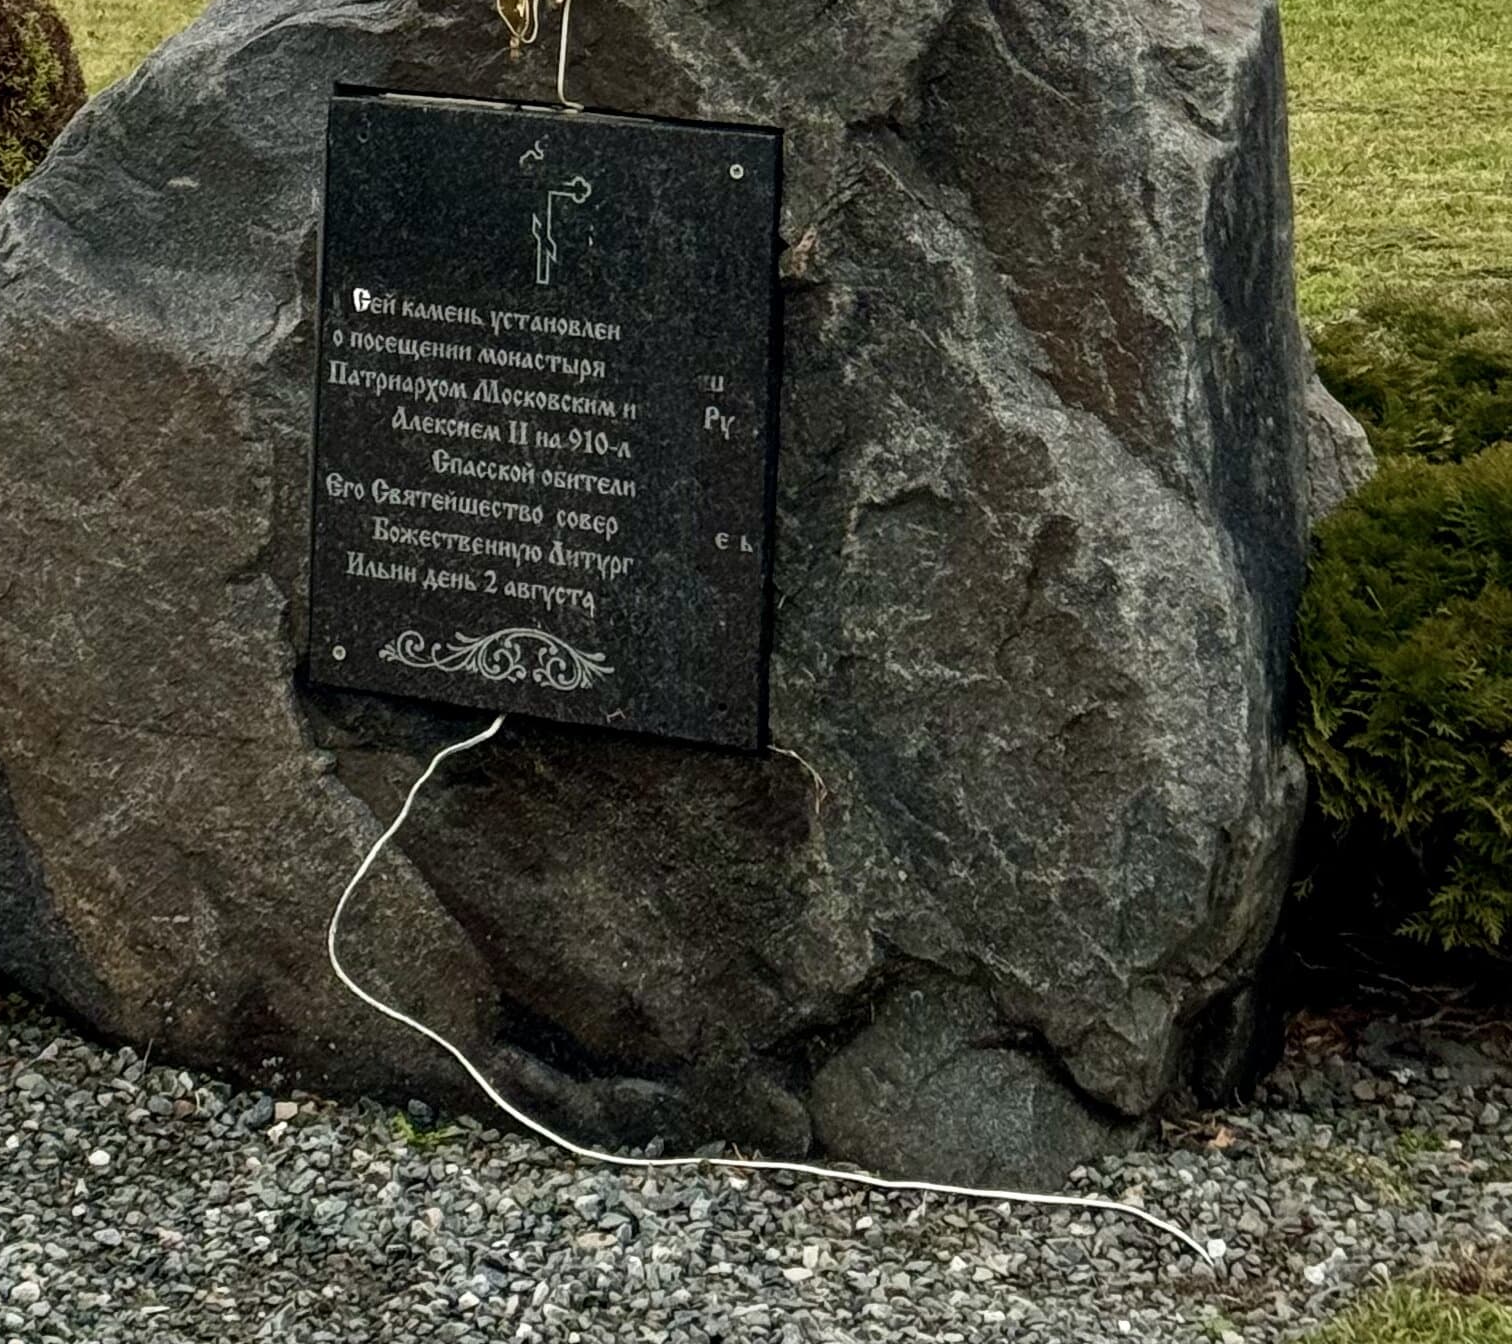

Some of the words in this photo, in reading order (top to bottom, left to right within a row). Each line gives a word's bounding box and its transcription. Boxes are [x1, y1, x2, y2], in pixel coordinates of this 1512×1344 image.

[353, 288, 396, 315] Сей
[402, 297, 484, 325] камень
[490, 310, 621, 341] установлен
[332, 329, 343, 346] о
[350, 330, 472, 361] посещении
[477, 347, 606, 383] монастыря
[328, 360, 468, 403] Патриархом
[473, 379, 616, 418] Московским
[391, 406, 501, 442] Алексием
[536, 430, 562, 450] на
[325, 472, 365, 501] Его
[372, 478, 544, 525] Святейшество
[432, 448, 535, 485] Спасской
[541, 469, 637, 498] обители
[372, 516, 542, 568] Божественную
[346, 551, 417, 584] Ильин
[422, 568, 478, 592] день
[483, 570, 498, 594] 2
[503, 579, 596, 618] августа
